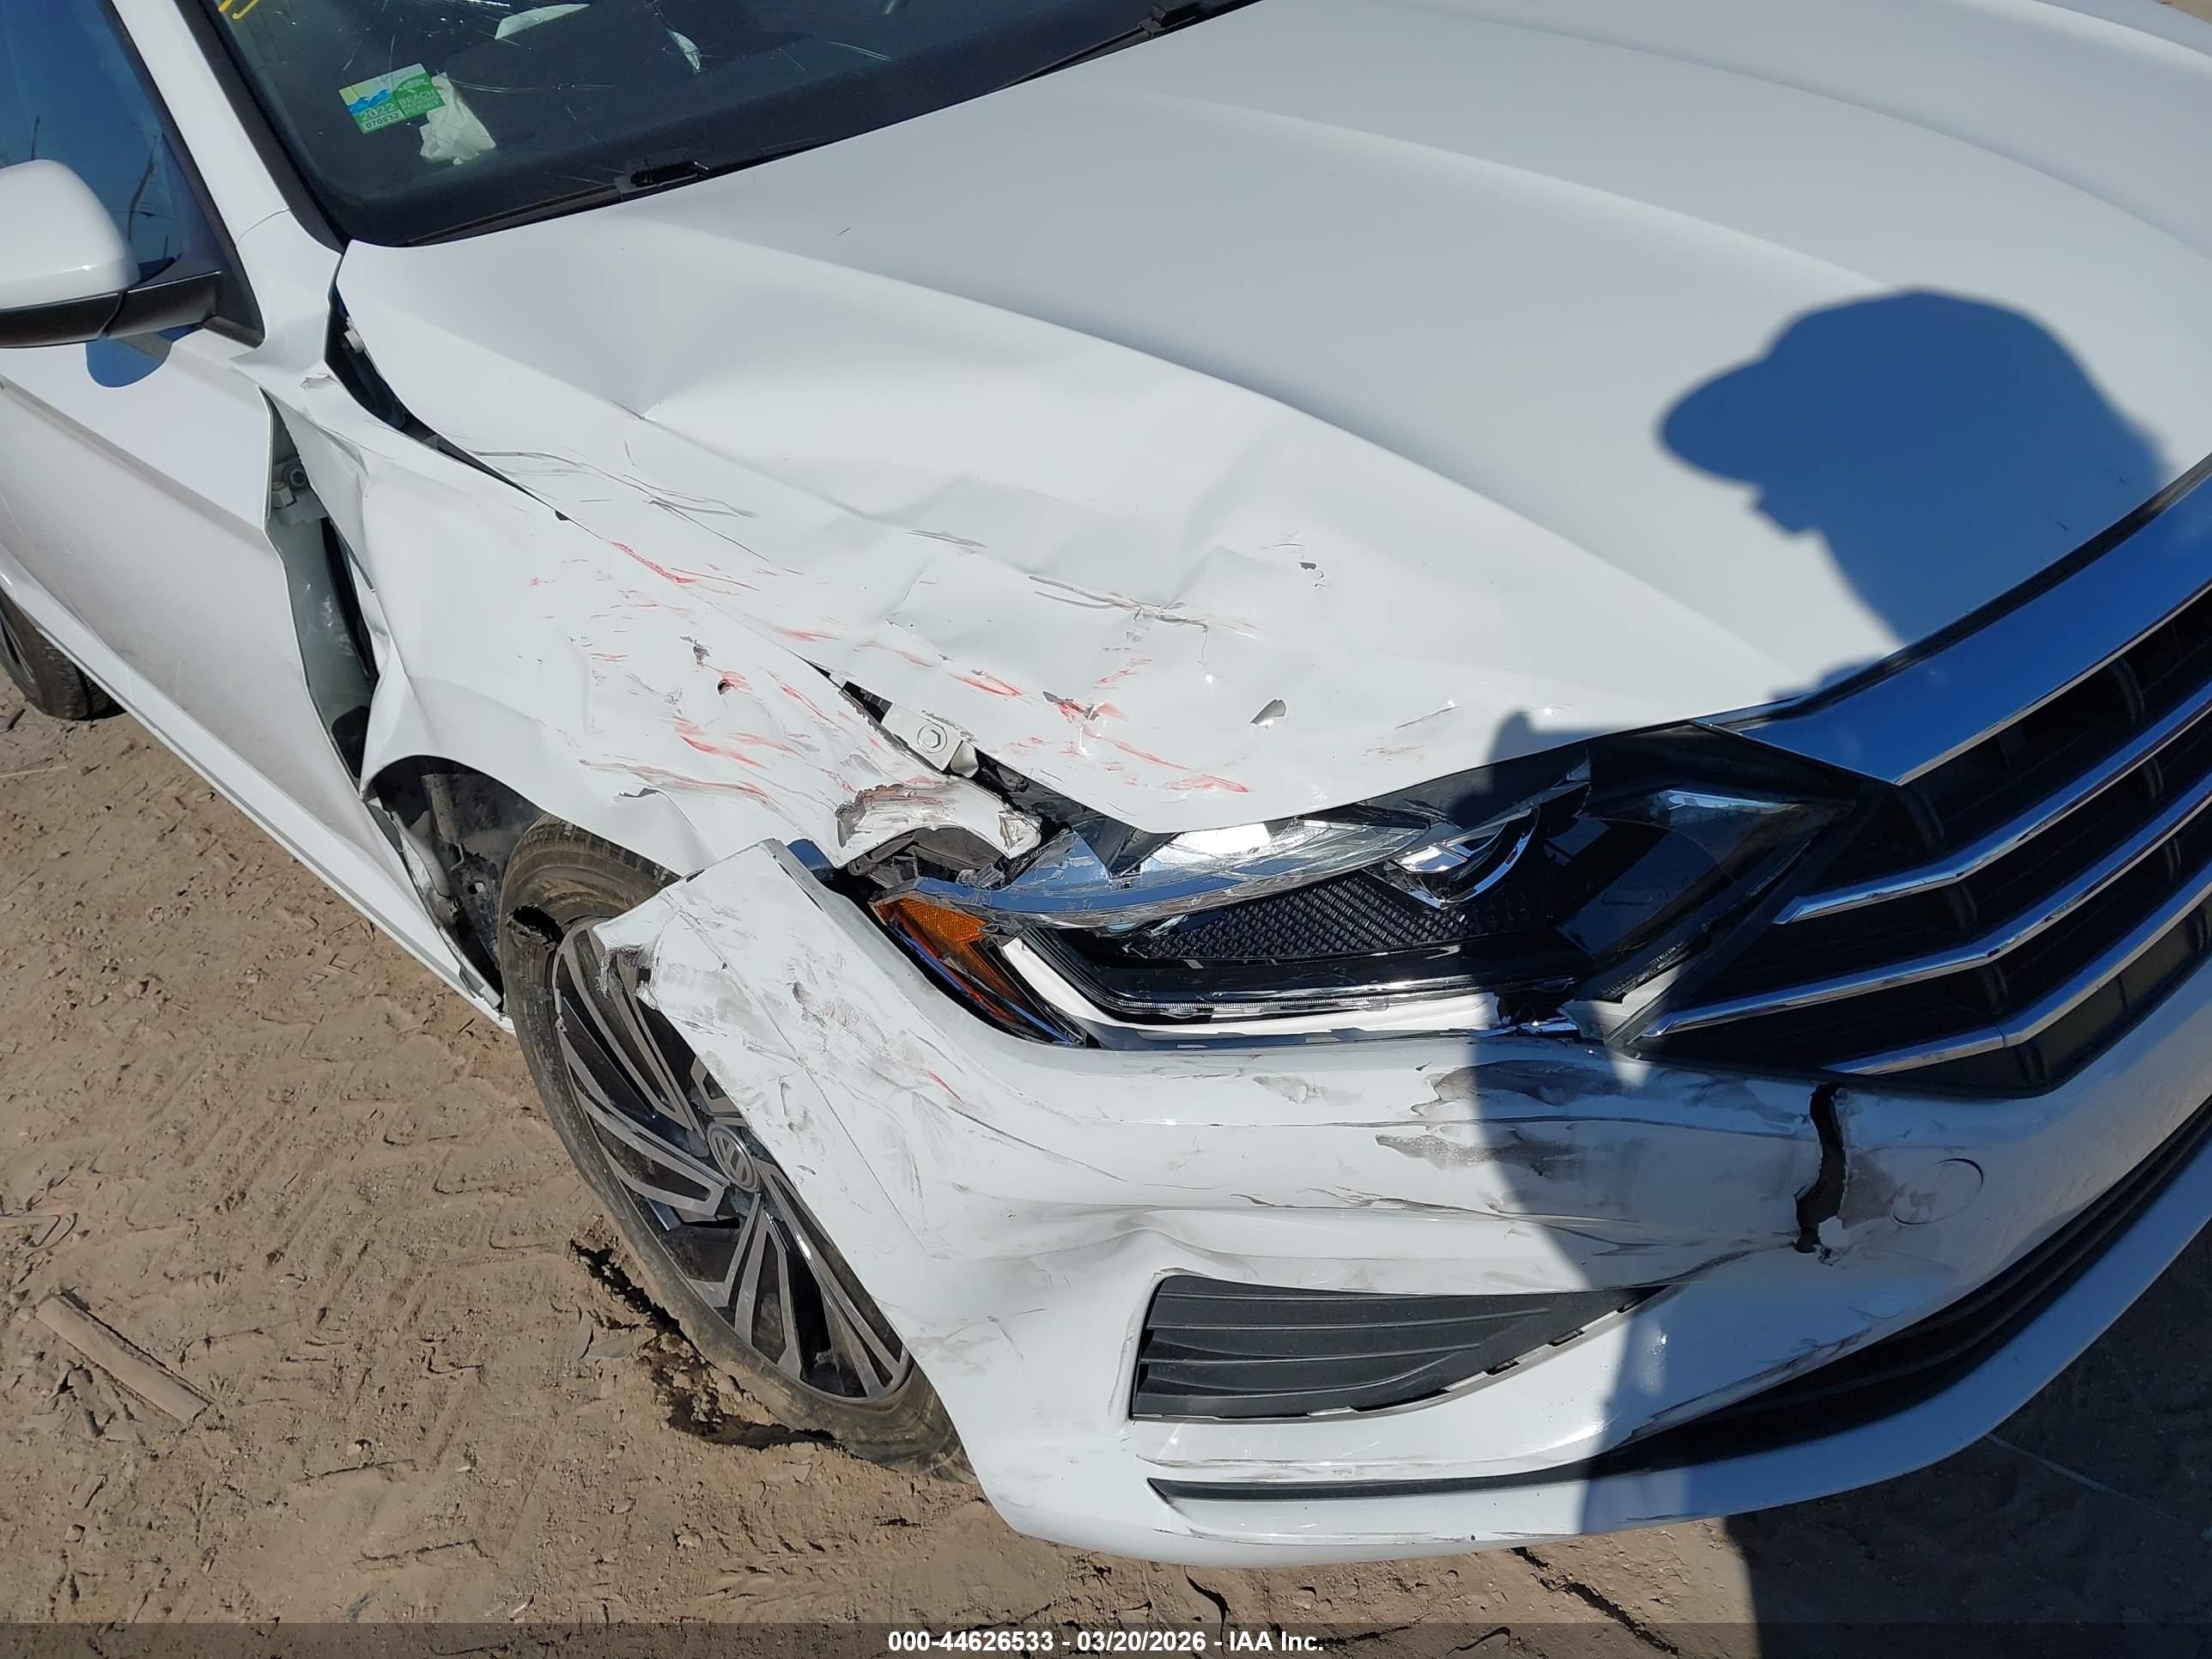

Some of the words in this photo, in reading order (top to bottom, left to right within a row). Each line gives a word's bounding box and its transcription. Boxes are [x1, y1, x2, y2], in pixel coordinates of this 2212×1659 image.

[398, 89, 436, 105] BEACH
[362, 103, 397, 120] 2022
[365, 112, 399, 129] 070832
